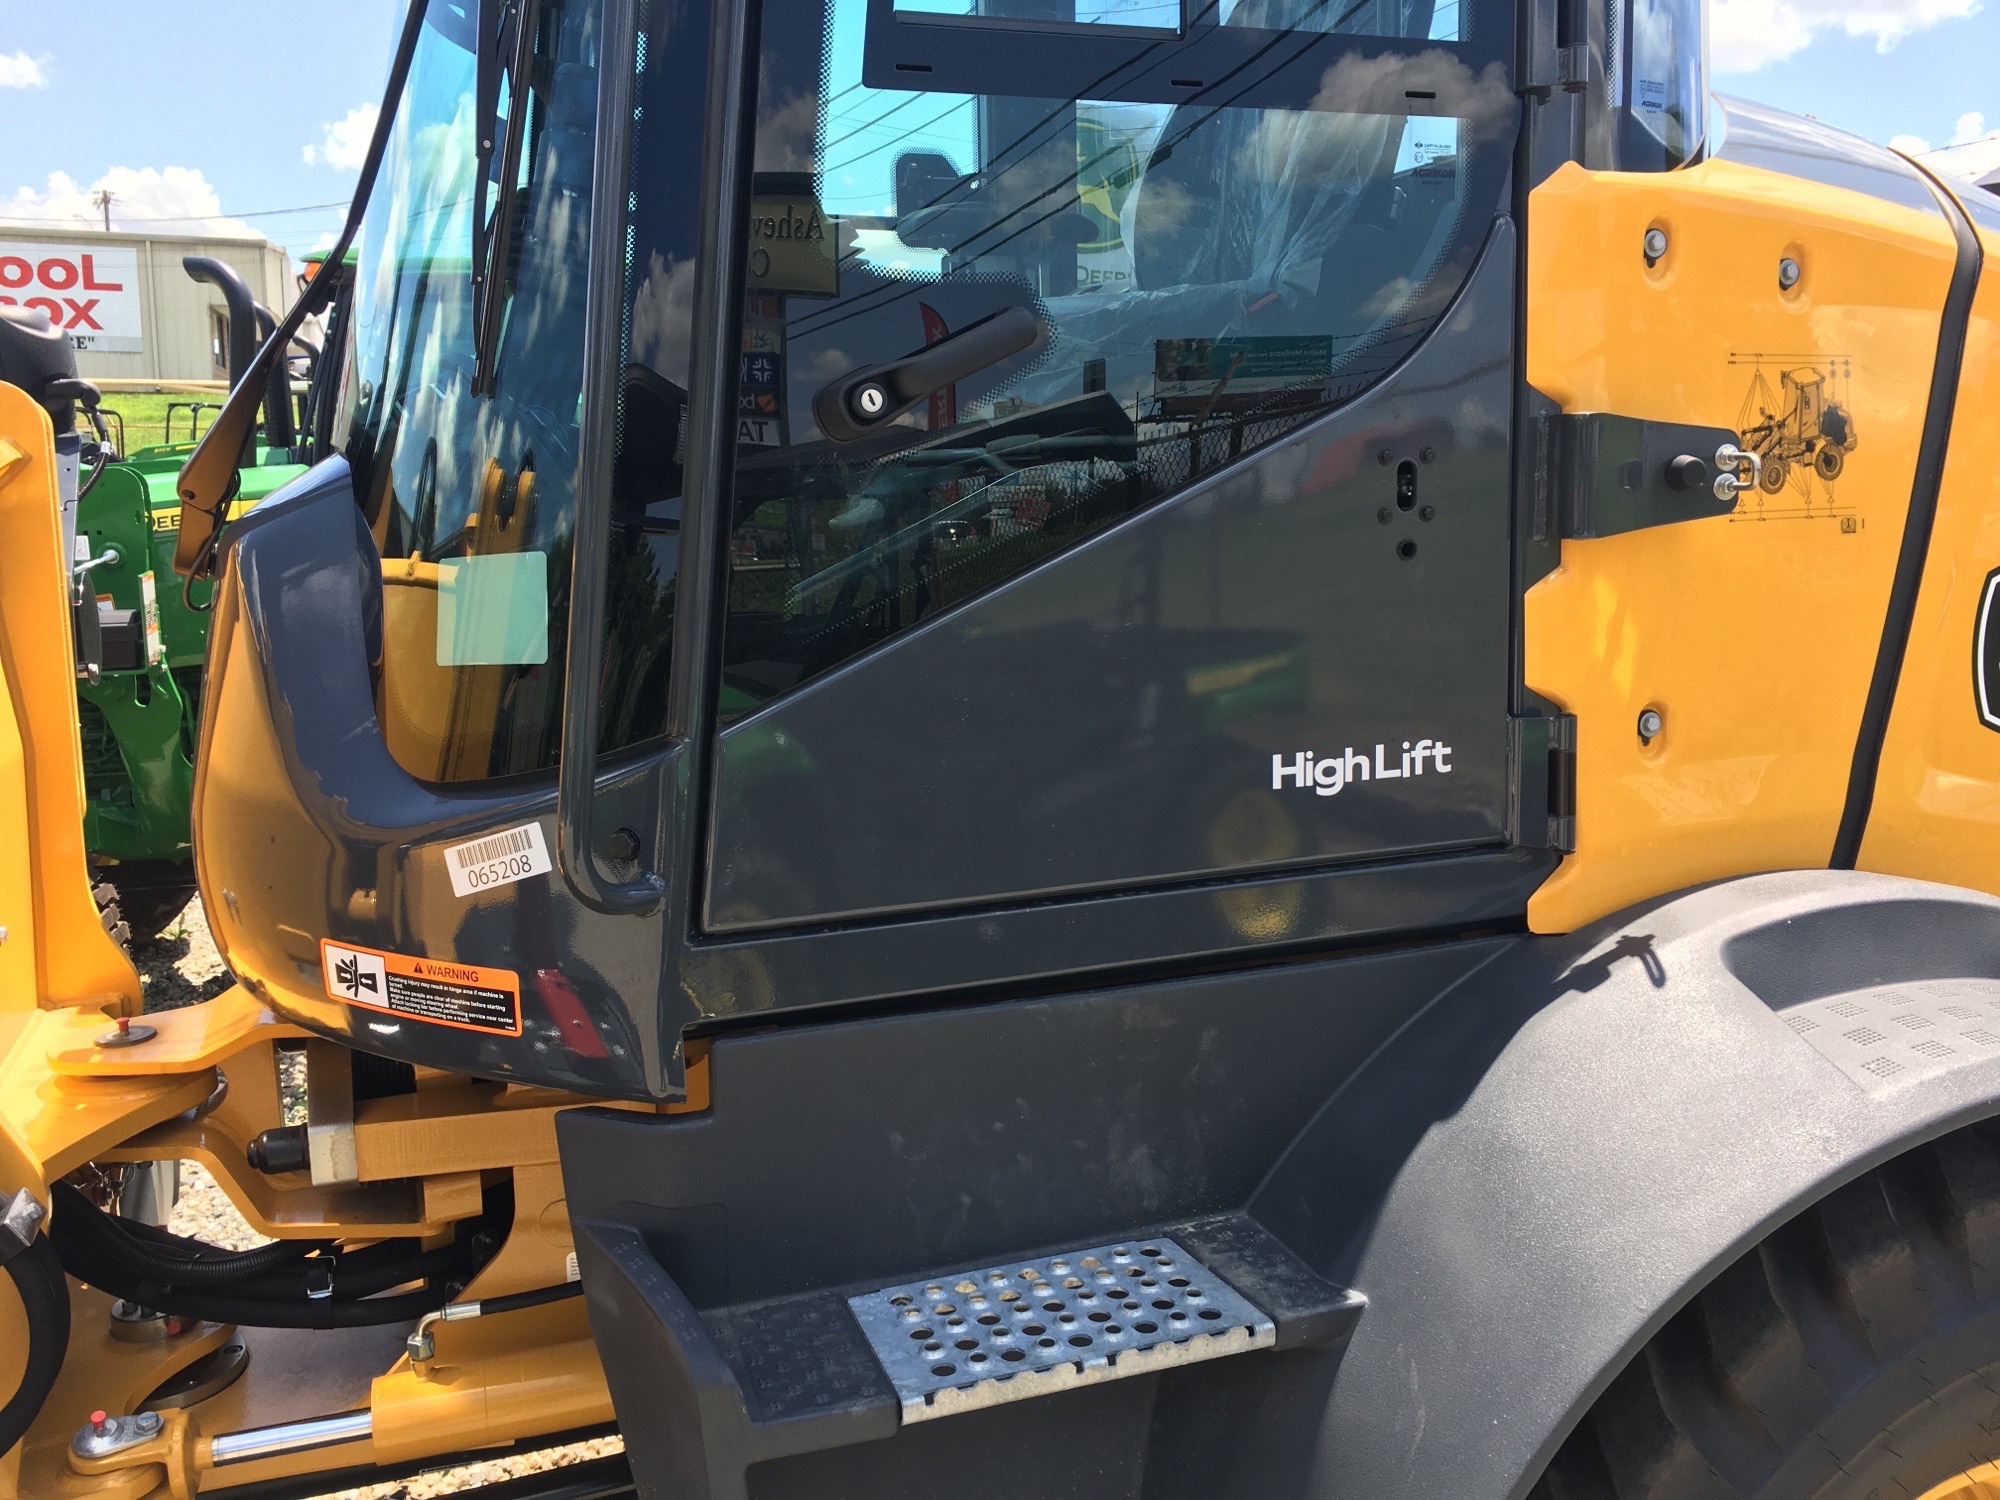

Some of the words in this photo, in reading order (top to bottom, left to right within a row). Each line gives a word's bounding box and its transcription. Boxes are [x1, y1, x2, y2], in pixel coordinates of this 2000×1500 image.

[0, 296, 104, 330] OX
[467, 854, 532, 888] 065208
[426, 964, 479, 982] WARNING
[389, 976, 407, 984] Crushing
[405, 1000, 420, 1009] locking
[443, 1008, 468, 1017] performing
[427, 1000, 444, 1008] steering
[487, 1004, 506, 1012] starting
[420, 1010, 446, 1020] transporting
